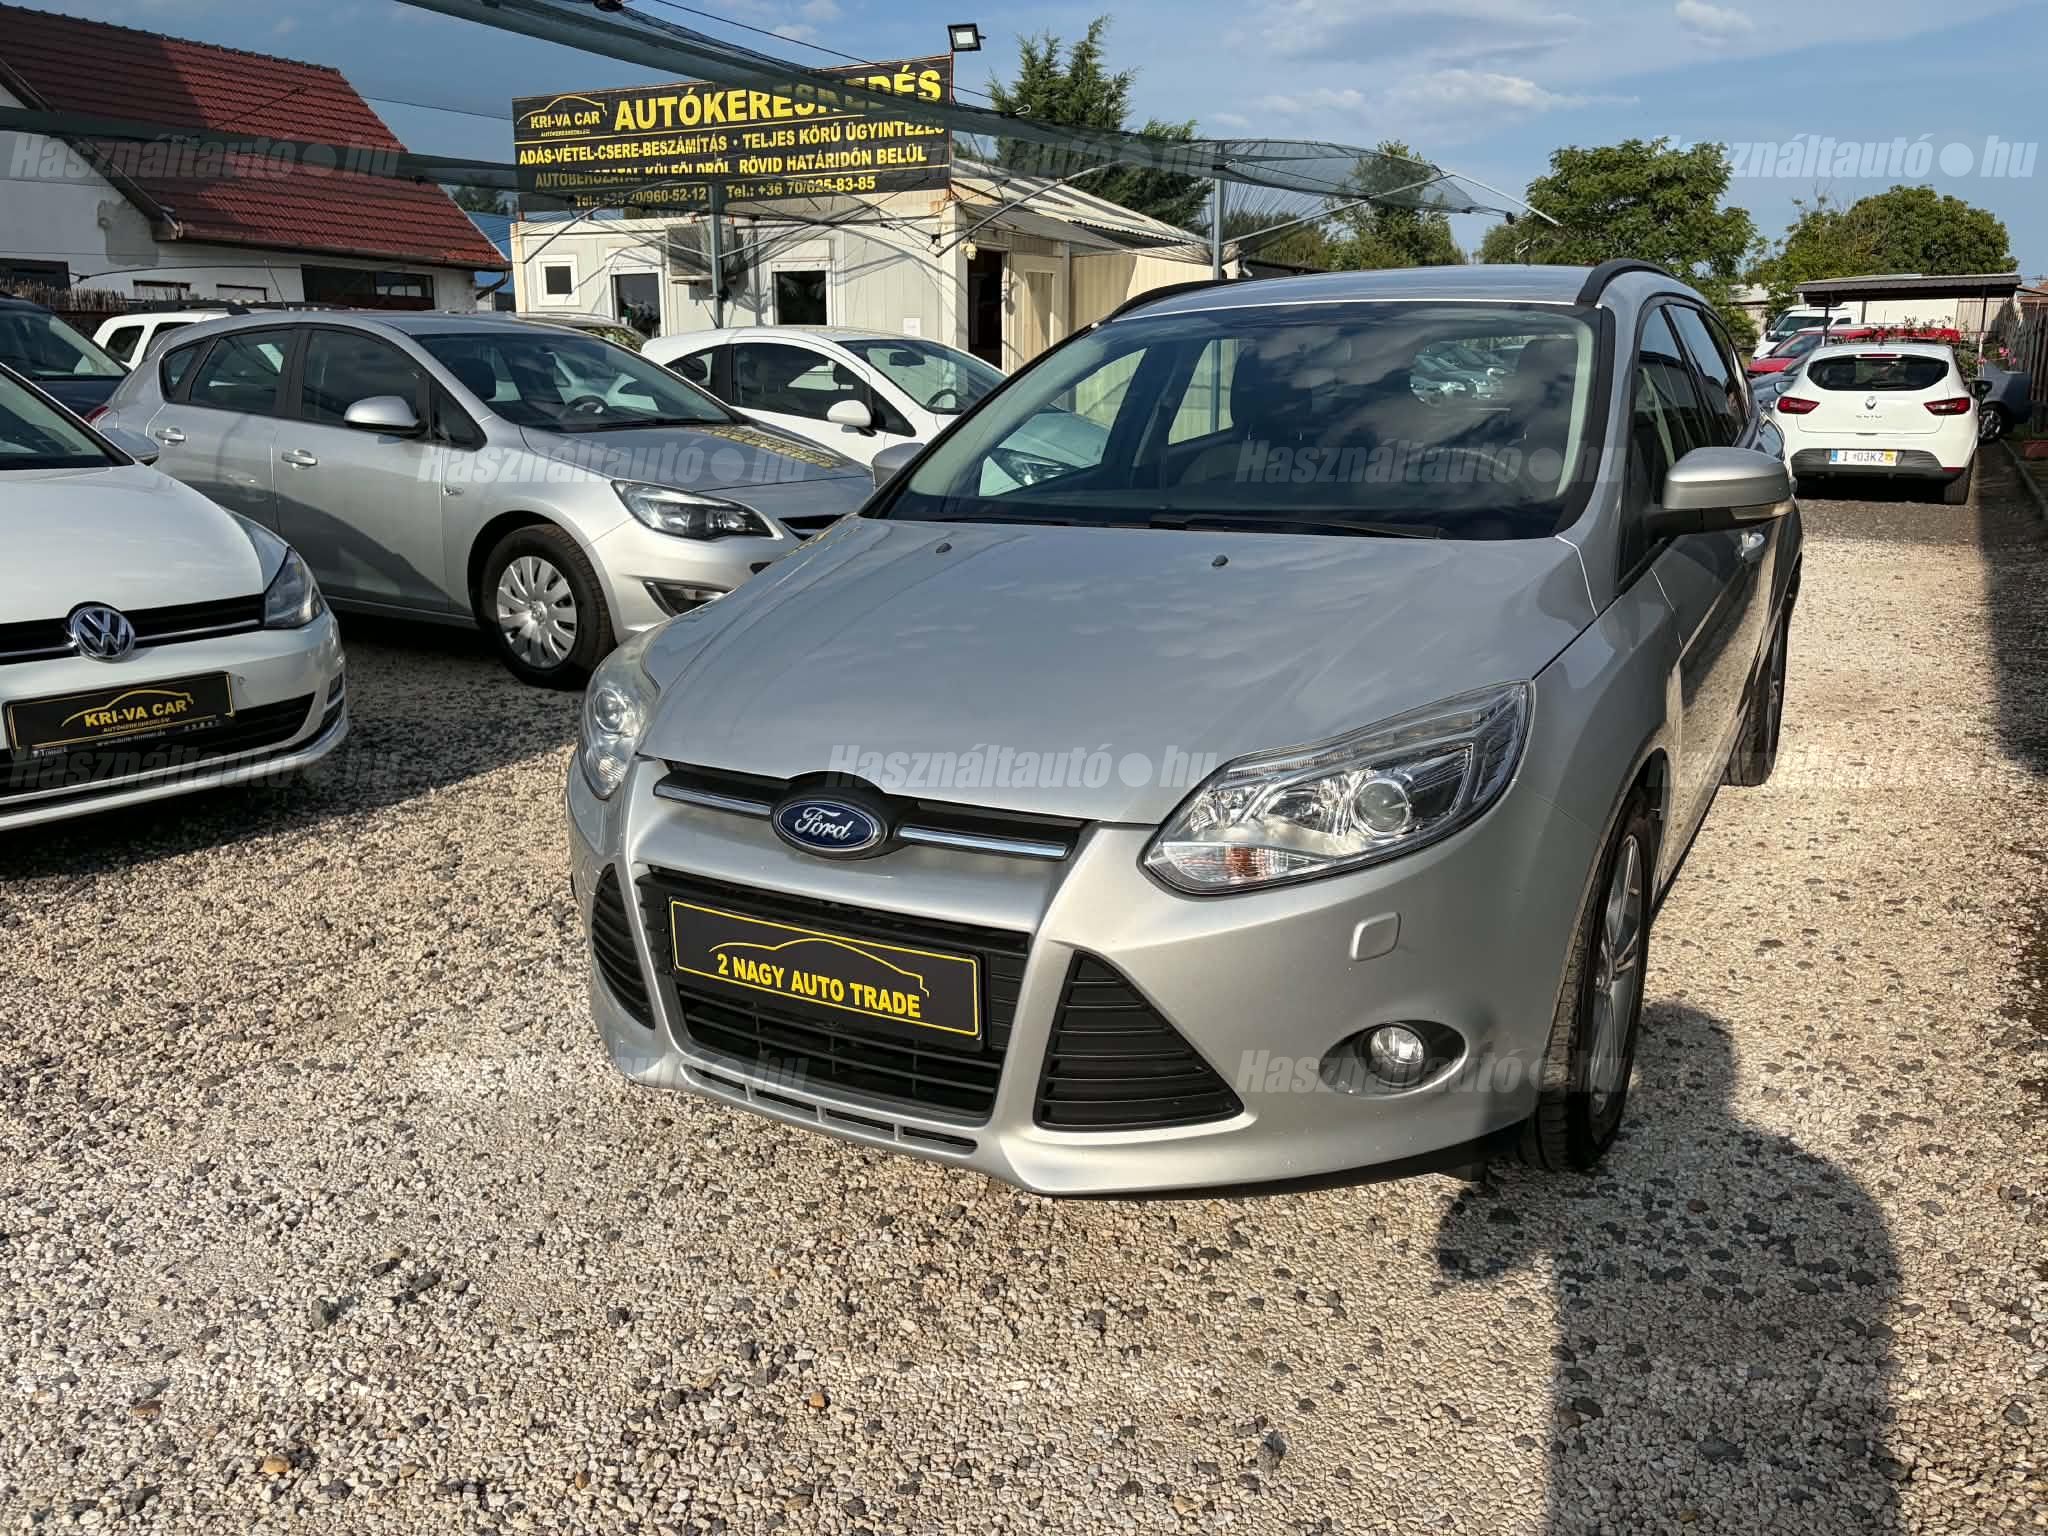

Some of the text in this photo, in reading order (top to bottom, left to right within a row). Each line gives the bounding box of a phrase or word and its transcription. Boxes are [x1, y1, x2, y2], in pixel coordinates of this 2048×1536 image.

[530, 111, 601, 129] KRI-VA CAR
[742, 130, 796, 149] TELJES
[739, 155, 783, 174] RÖVID
[876, 144, 928, 164] BELÜL
[84, 699, 188, 728] KRI-VA CAR
[794, 806, 855, 840] Ford
[717, 953, 921, 1018] 2 NAGY AUTO TRADE
